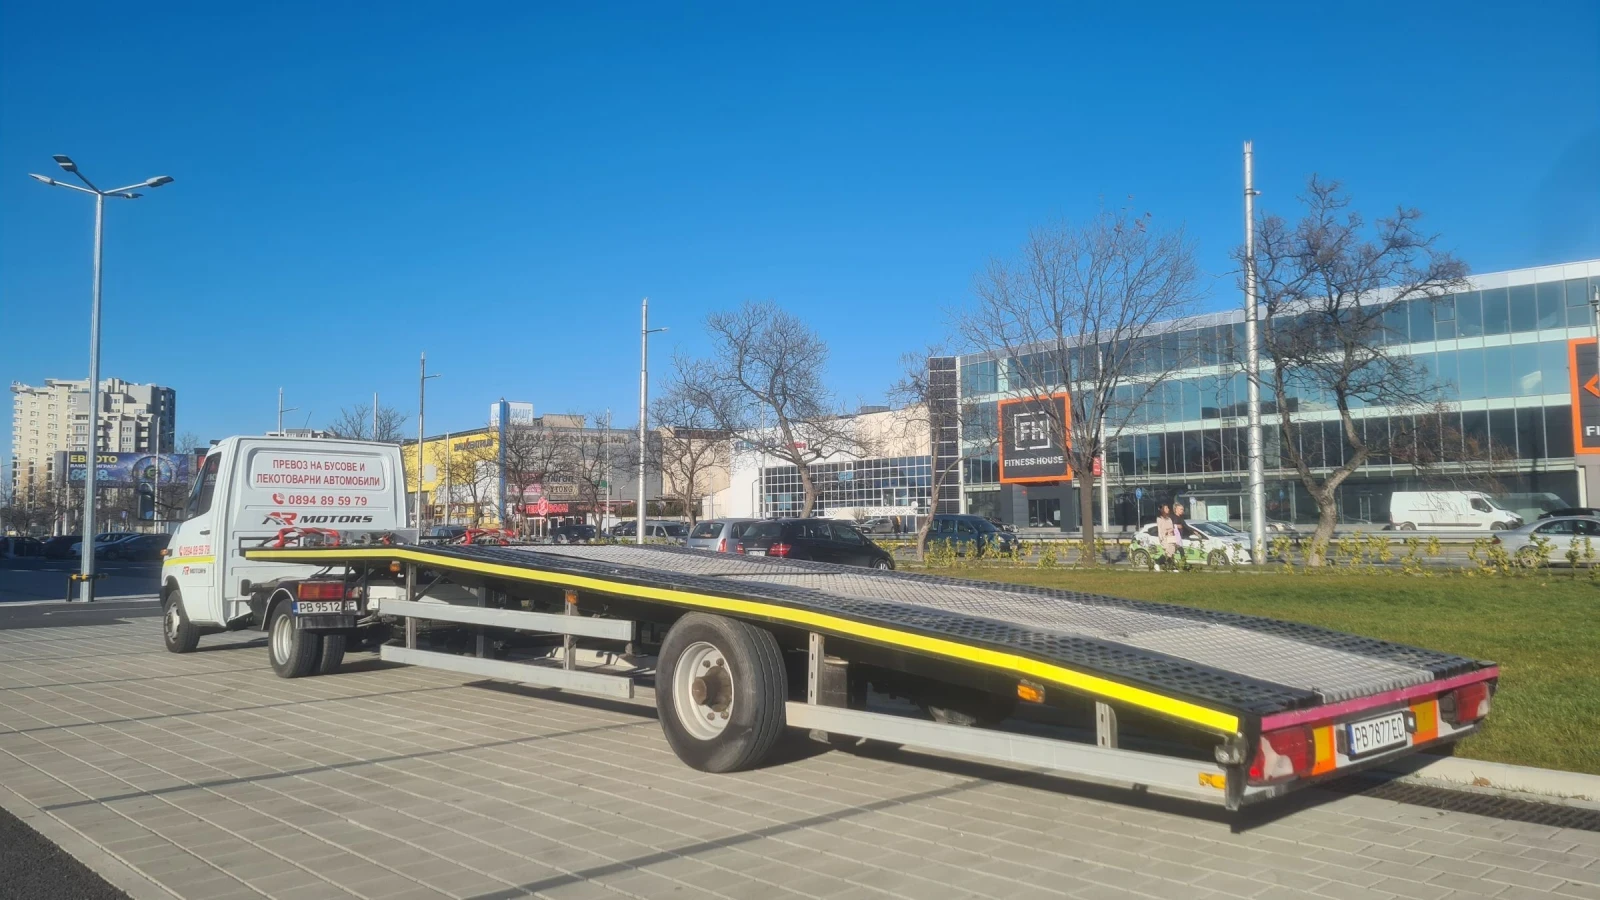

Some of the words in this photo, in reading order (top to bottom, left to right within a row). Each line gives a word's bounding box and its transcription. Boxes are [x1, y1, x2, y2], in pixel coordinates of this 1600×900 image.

[70, 455, 118, 463] ЕВОТО
[1004, 457, 1036, 467] FITNESS
[1036, 455, 1064, 465] HOUSE
[273, 459, 308, 470] ПРЕВОЗ
[311, 461, 322, 470] НА
[325, 461, 357, 471] БУСОВЕ
[360, 462, 365, 471] И
[256, 473, 321, 485] ЛЕКОТОВАРНИ
[323, 475, 380, 486] АВТОМОБИЛИ
[288, 495, 316, 505] 0894
[320, 496, 334, 505] 89
[338, 496, 351, 506] 59
[354, 496, 368, 506] 79
[299, 515, 373, 524] MOTORS
[300, 603, 314, 612] PB
[315, 602, 340, 612] 9512
[1355, 726, 1368, 750] PB
[1369, 720, 1390, 746] 7877
